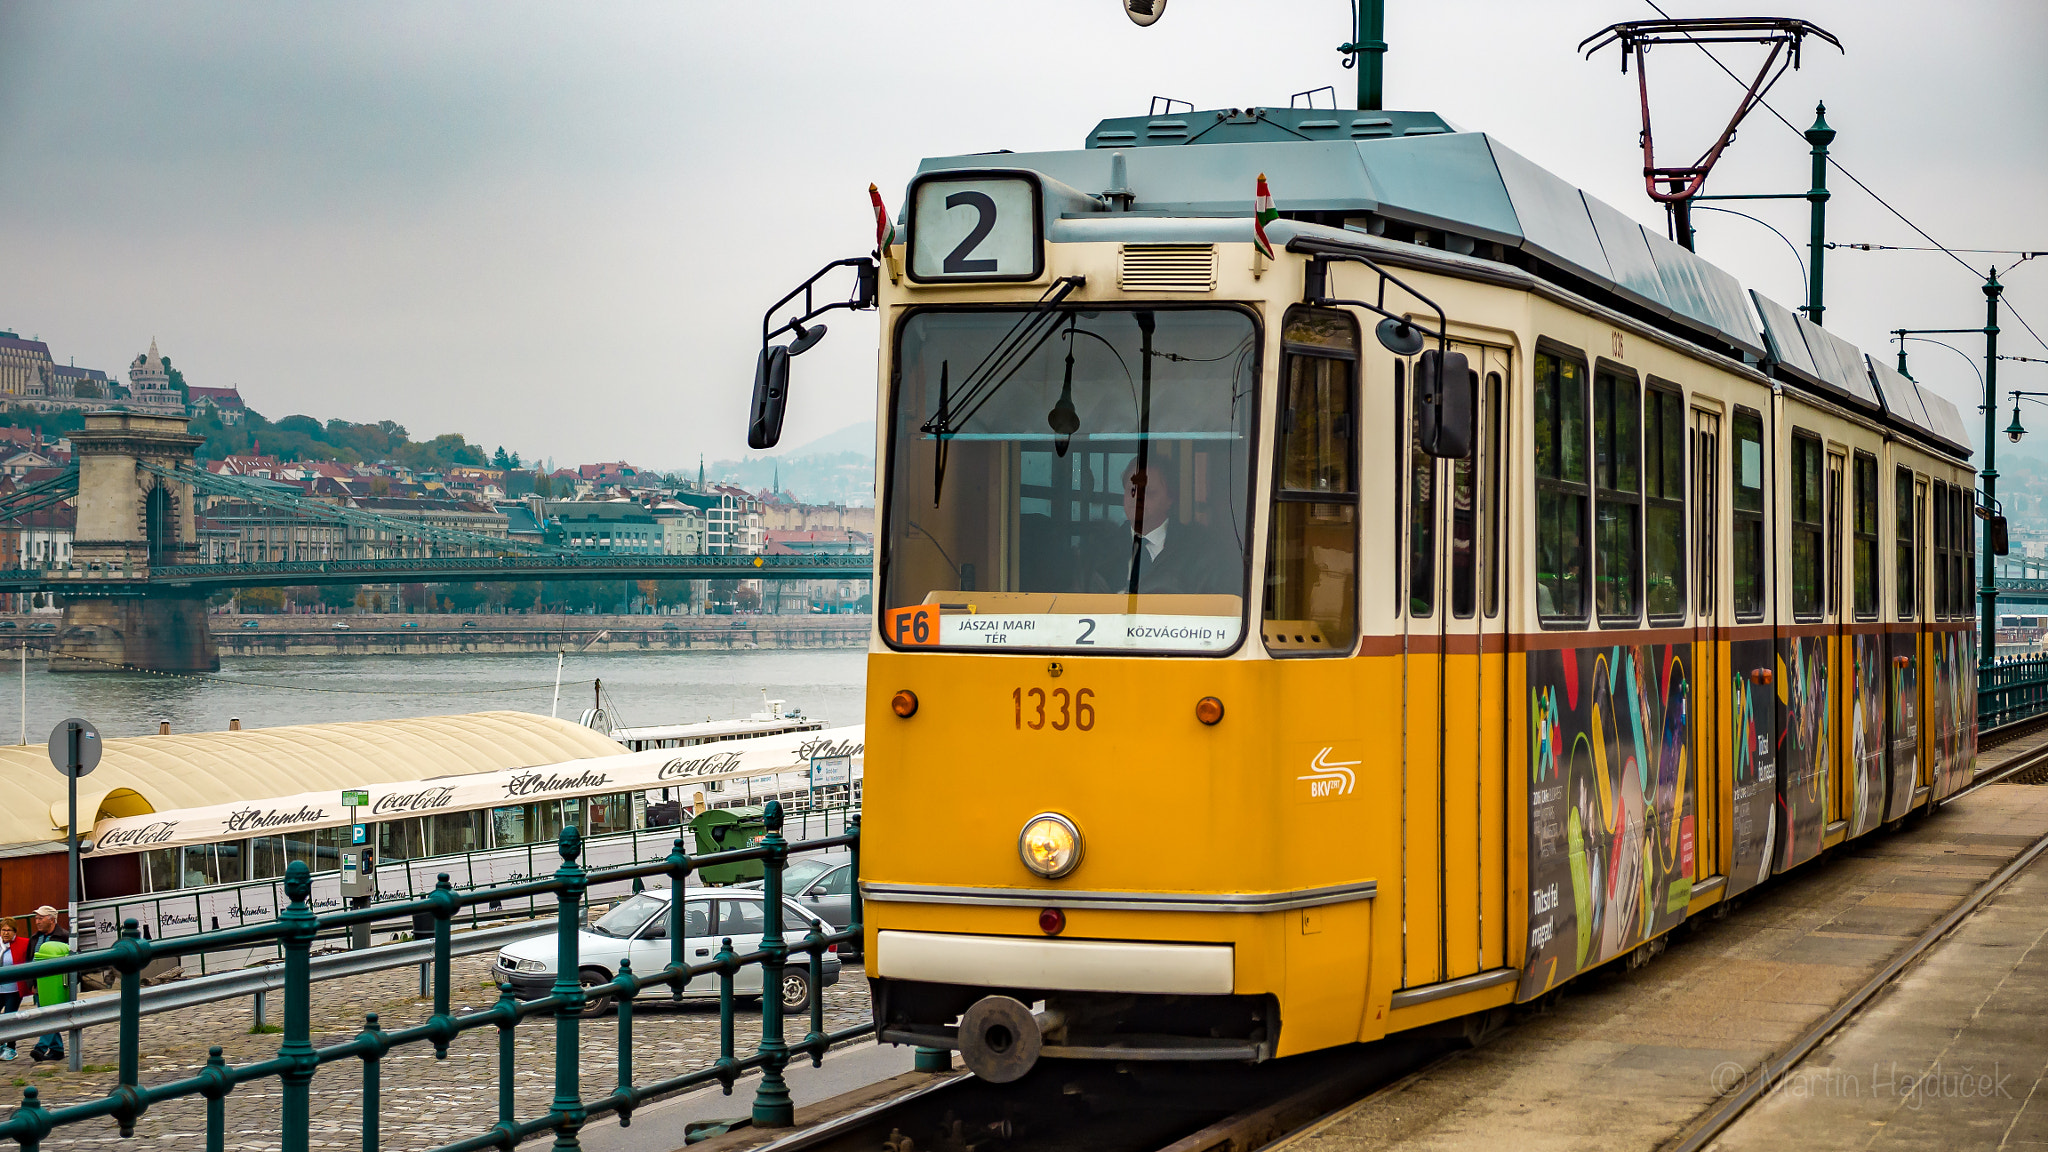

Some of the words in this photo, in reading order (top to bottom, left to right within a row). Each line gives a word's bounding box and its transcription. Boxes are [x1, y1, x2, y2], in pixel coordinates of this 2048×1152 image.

[943, 191, 997, 273] 2
[896, 611, 929, 644] F6
[959, 619, 999, 631] JÁSZAI
[1003, 620, 1036, 630] MARI
[1075, 618, 1096, 645] 2
[1127, 625, 1212, 639] KÖZVÁGÓHÍD
[1216, 629, 1225, 639] H
[985, 632, 1007, 644] TÉR
[1013, 687, 1095, 731] 1336
[519, 770, 614, 796] Columbus
[1311, 781, 1331, 797] BKV
[238, 805, 330, 831] Columbus
[354, 827, 364, 841] P
[235, 905, 270, 917] Clumbus
